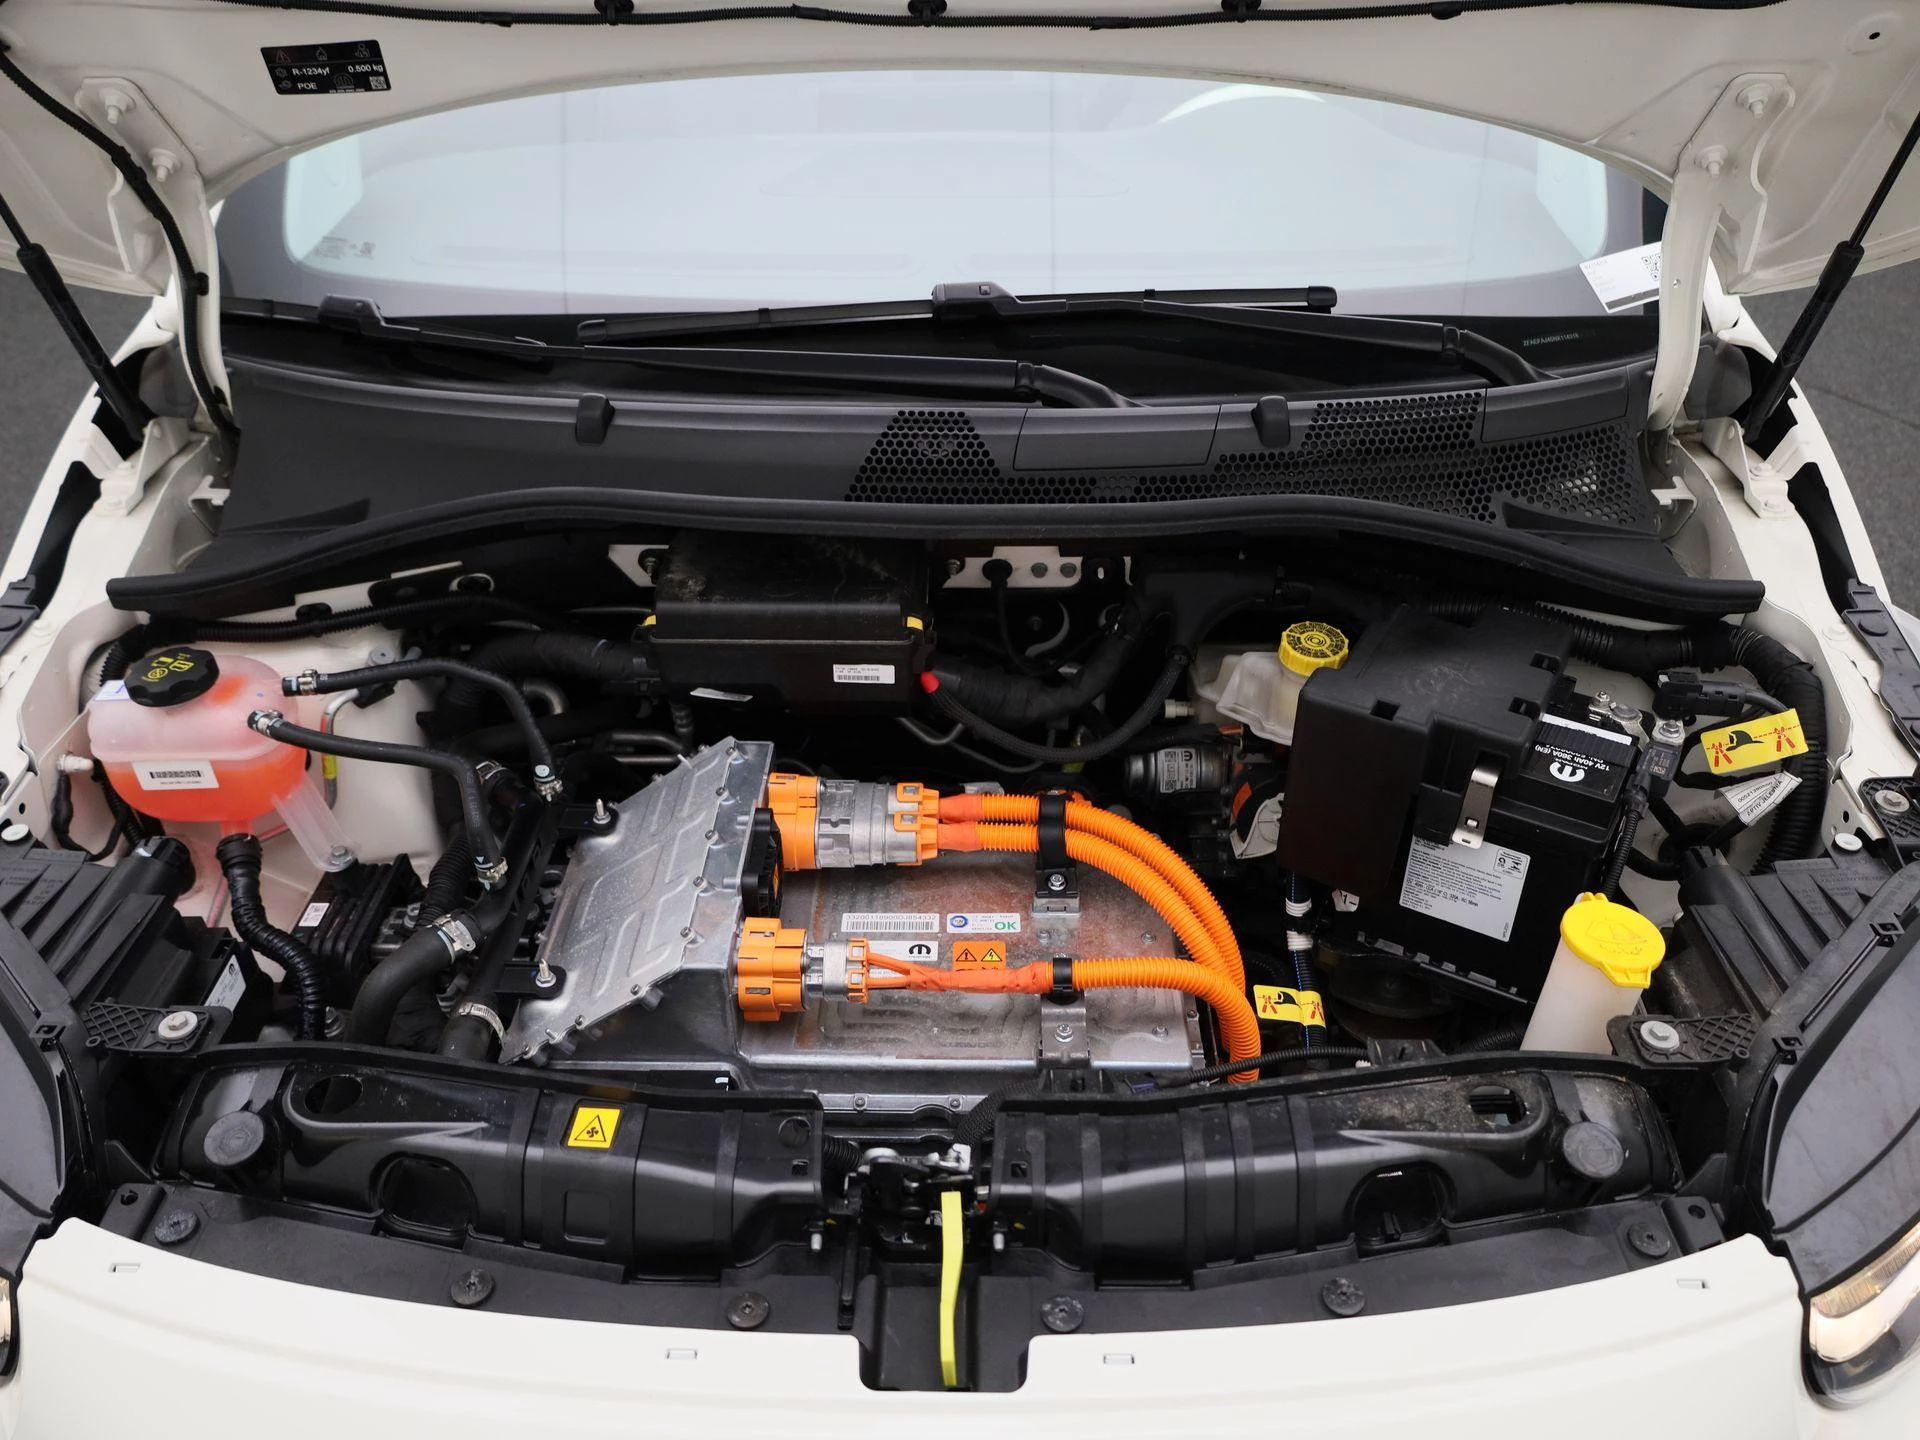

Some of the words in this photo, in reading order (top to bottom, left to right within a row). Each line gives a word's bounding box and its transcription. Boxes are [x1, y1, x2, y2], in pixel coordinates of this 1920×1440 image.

[347, 64, 371, 73] 0.500
[373, 63, 384, 73] kg
[297, 82, 318, 90] POE
[1534, 744, 1551, 754] (EN)
[1552, 750, 1573, 761] 360A
[1573, 756, 1594, 766] 40Ah
[1594, 763, 1610, 771] 12V
[994, 921, 1017, 931] OK
